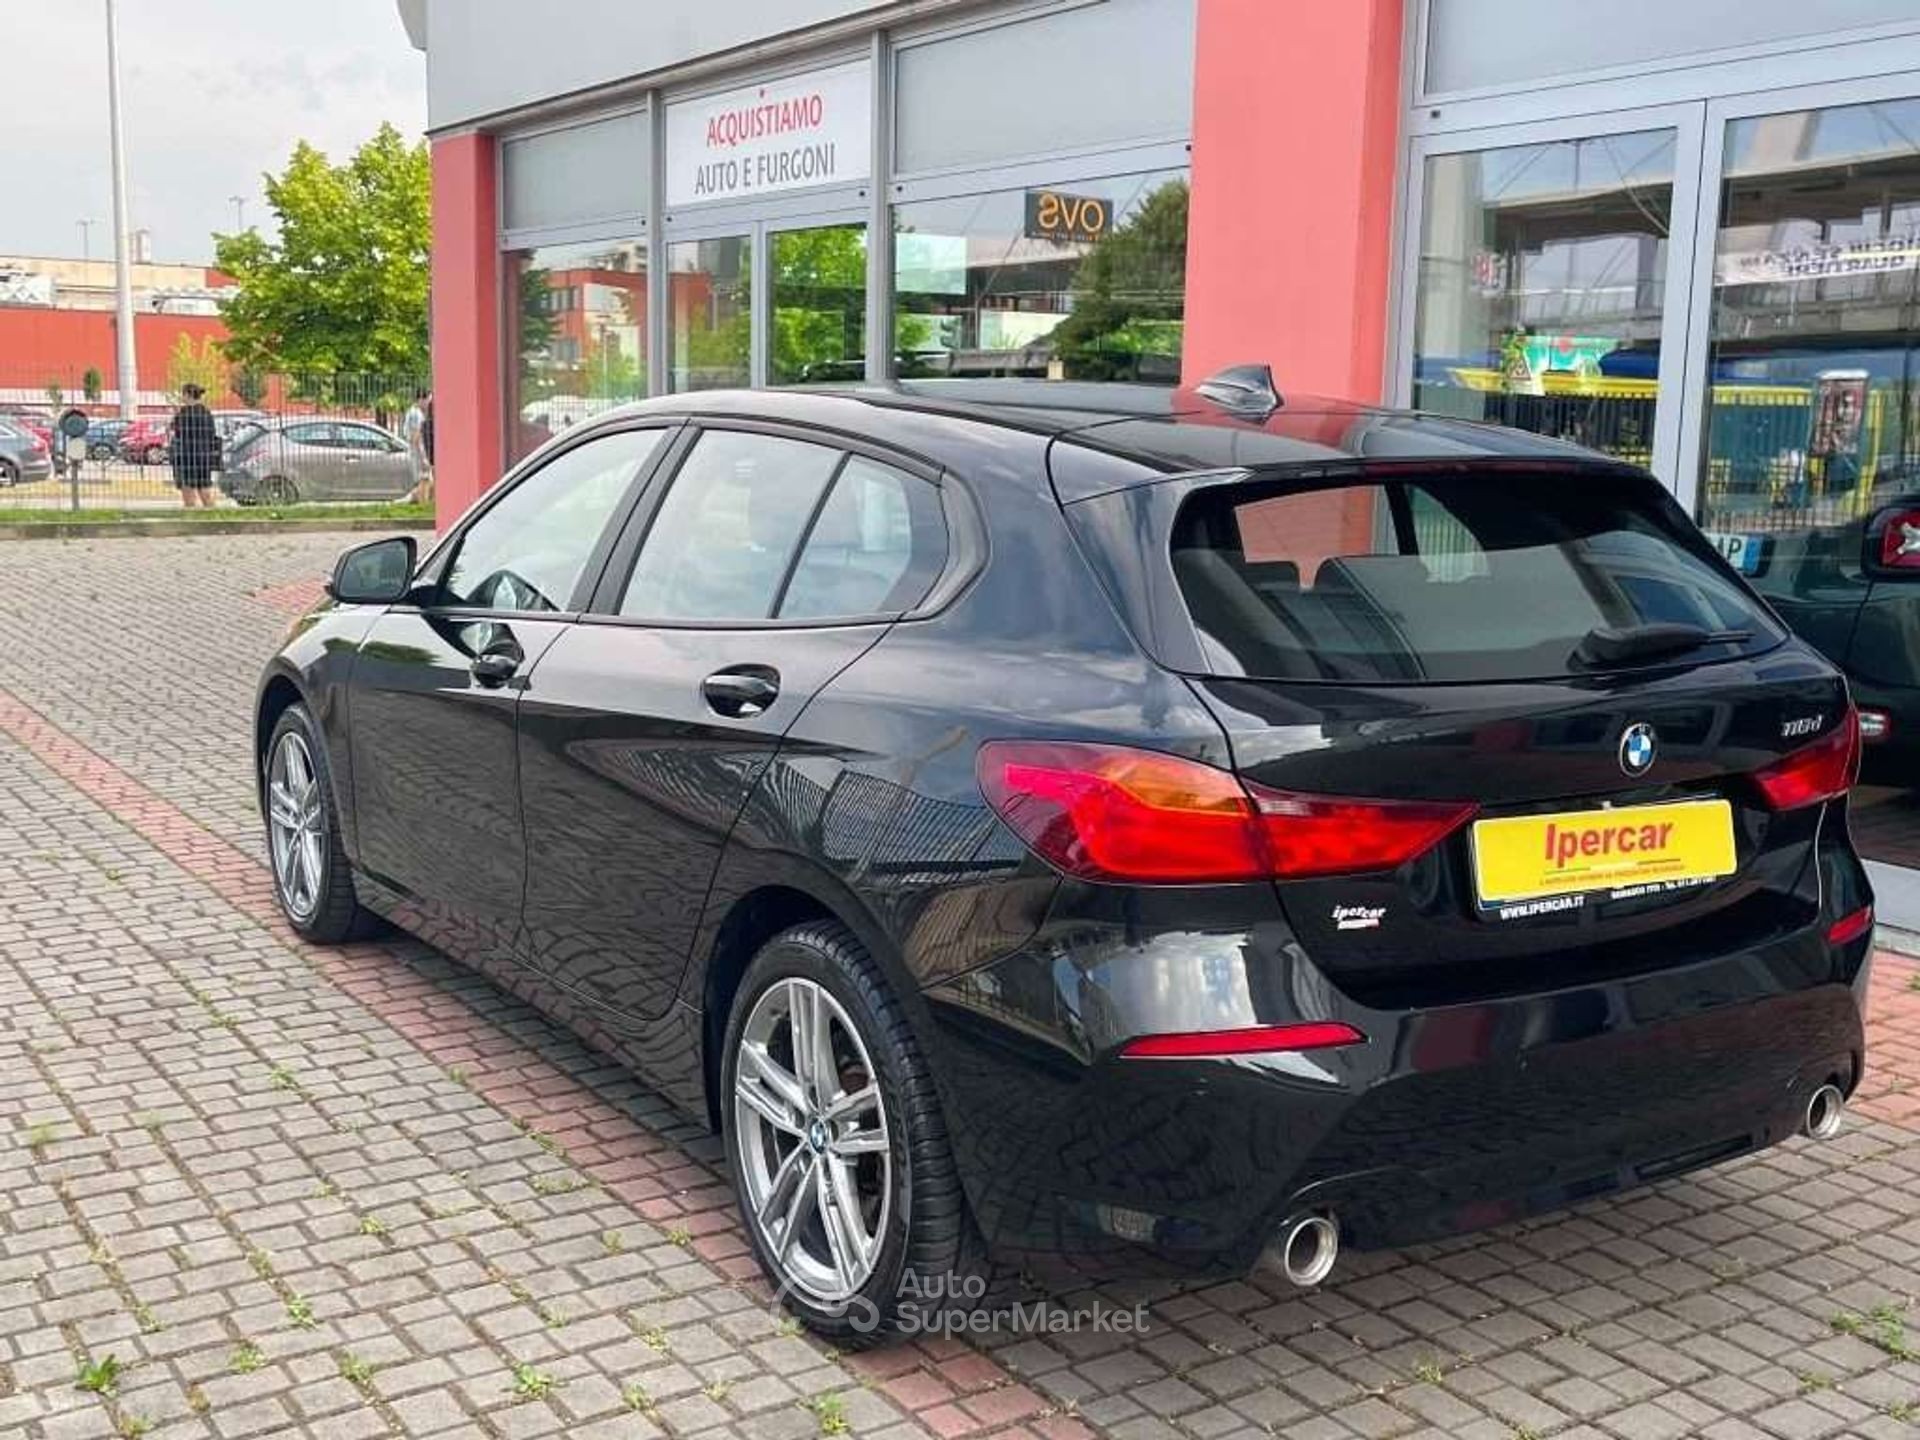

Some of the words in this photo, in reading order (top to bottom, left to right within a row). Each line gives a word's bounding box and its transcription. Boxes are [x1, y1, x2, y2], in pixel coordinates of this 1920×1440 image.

[706, 94, 823, 147] ACQUISTIAMO
[694, 160, 738, 195] AUTO
[743, 157, 752, 187] E
[757, 142, 836, 185] FURGONI
[1544, 822, 1674, 868] Ipercar
